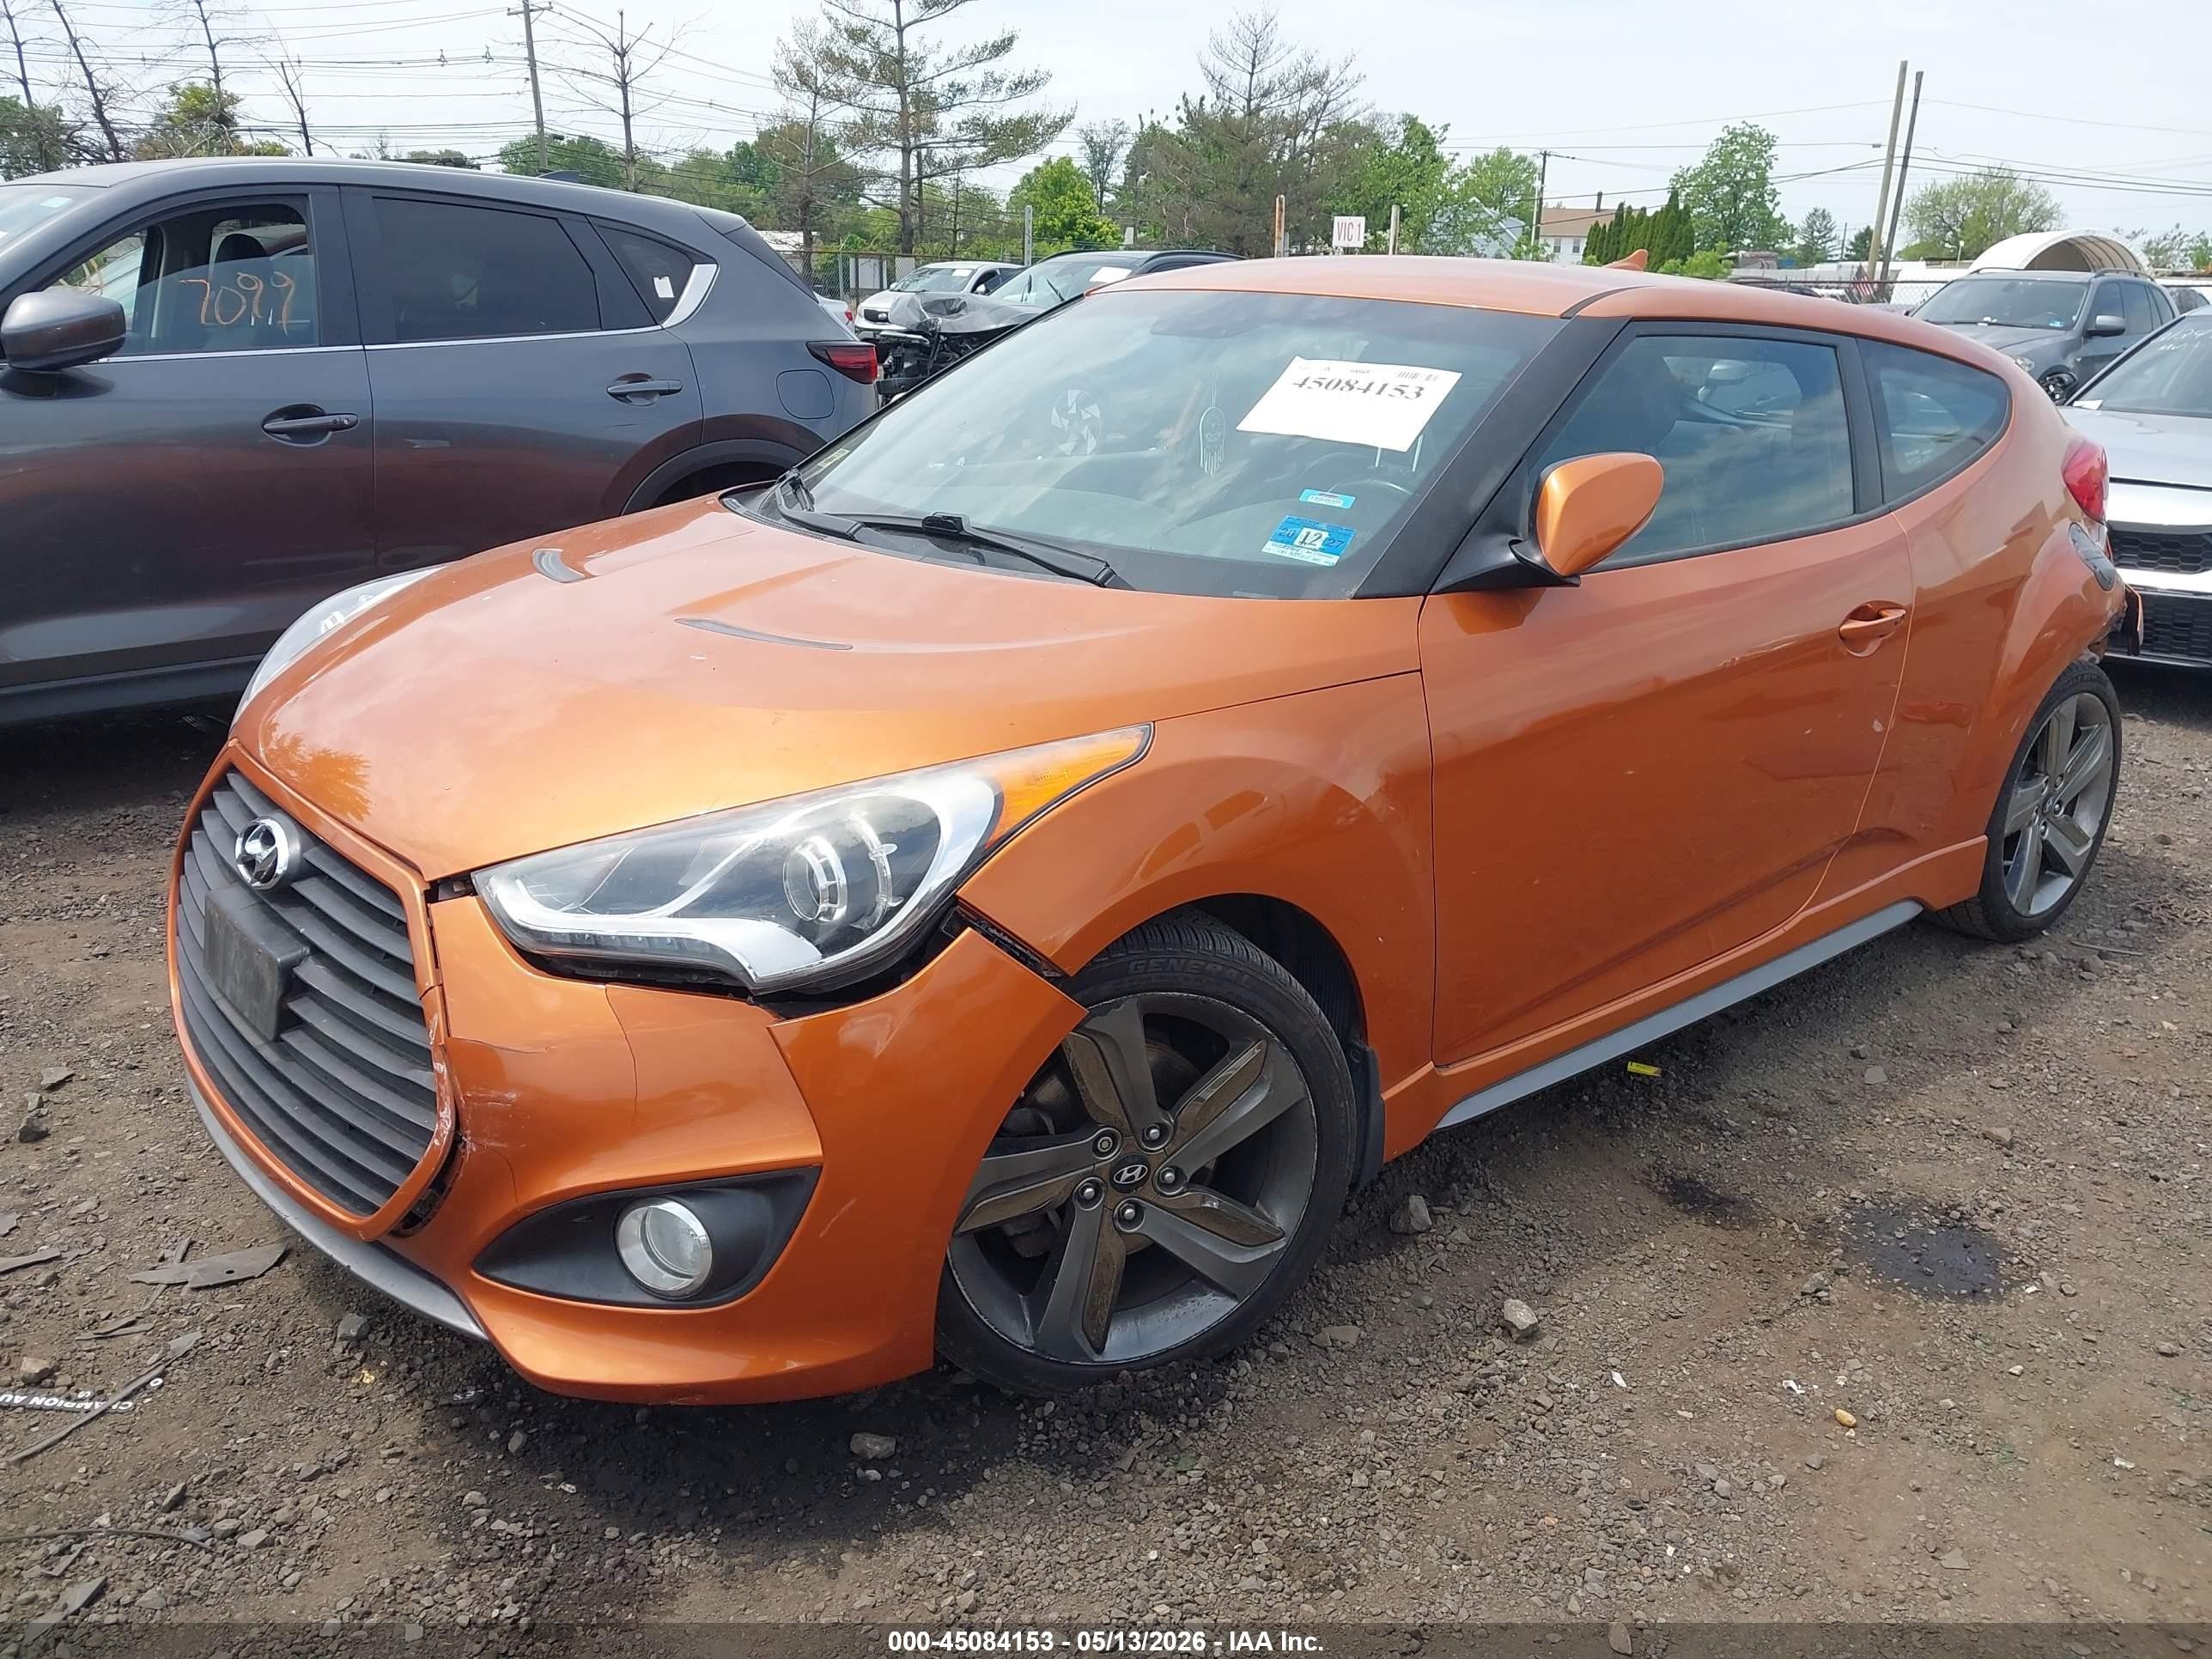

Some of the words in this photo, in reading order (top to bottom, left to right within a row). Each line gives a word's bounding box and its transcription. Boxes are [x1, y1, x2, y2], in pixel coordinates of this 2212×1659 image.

[1337, 222, 1354, 241] VIC
[1357, 222, 1362, 241] 1
[179, 270, 295, 336] 7099
[1292, 375, 1425, 400] 45084153
[1297, 530, 1323, 547] 12
